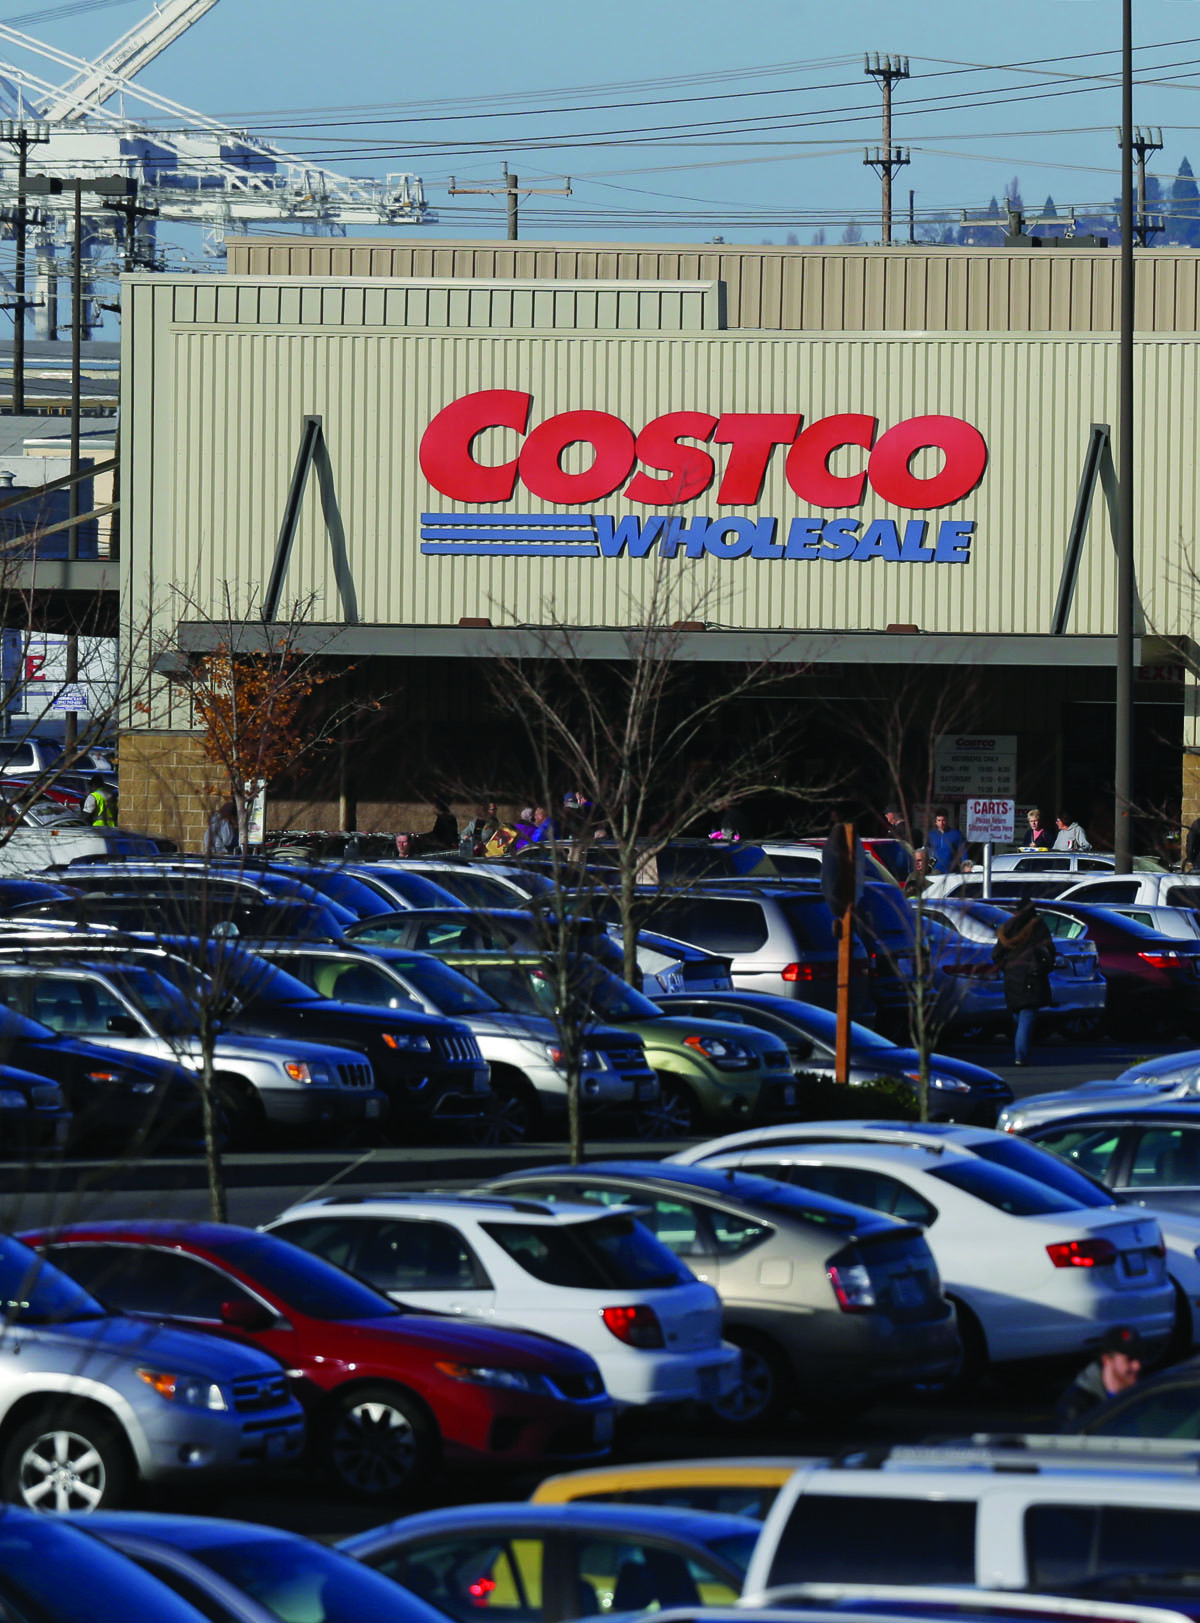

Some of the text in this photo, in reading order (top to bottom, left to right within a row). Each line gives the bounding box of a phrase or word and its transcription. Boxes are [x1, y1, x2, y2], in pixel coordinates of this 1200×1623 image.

[418, 389, 988, 509] COSTCO
[597, 514, 975, 563] WHOLESALE
[1138, 664, 1185, 681] EXIT
[955, 738, 996, 747] COSTCO
[974, 801, 1008, 815] CARTS
